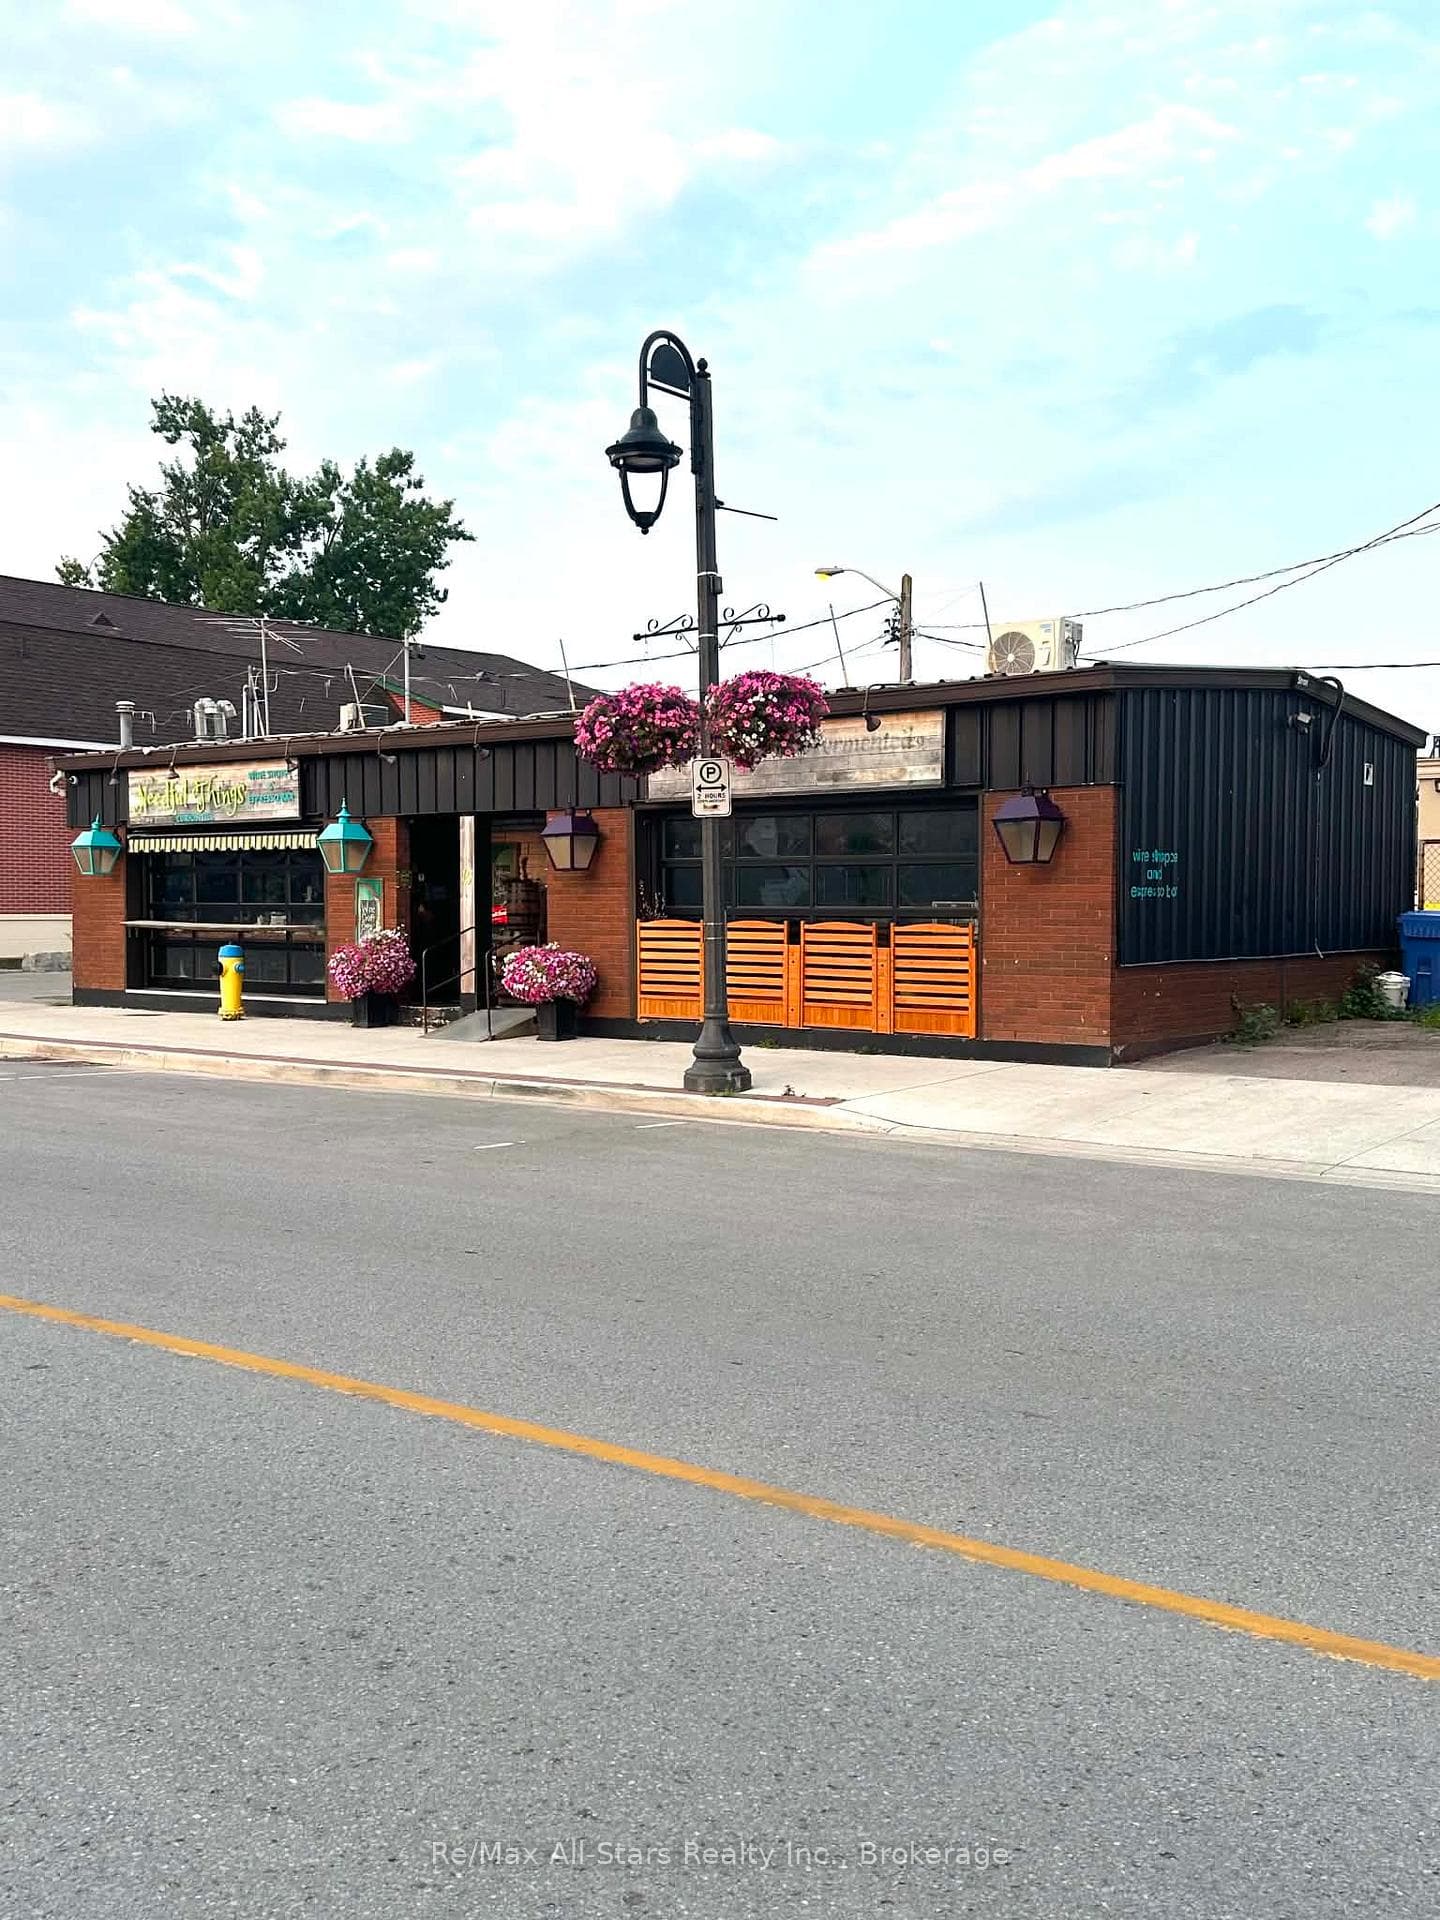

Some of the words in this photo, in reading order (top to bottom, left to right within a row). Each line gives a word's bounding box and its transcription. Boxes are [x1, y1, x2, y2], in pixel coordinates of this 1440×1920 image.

[706, 766, 716, 779] P
[134, 778, 190, 816] Needful
[191, 774, 247, 817] Things
[704, 791, 726, 799] HOURS
[1146, 866, 1163, 880] and
